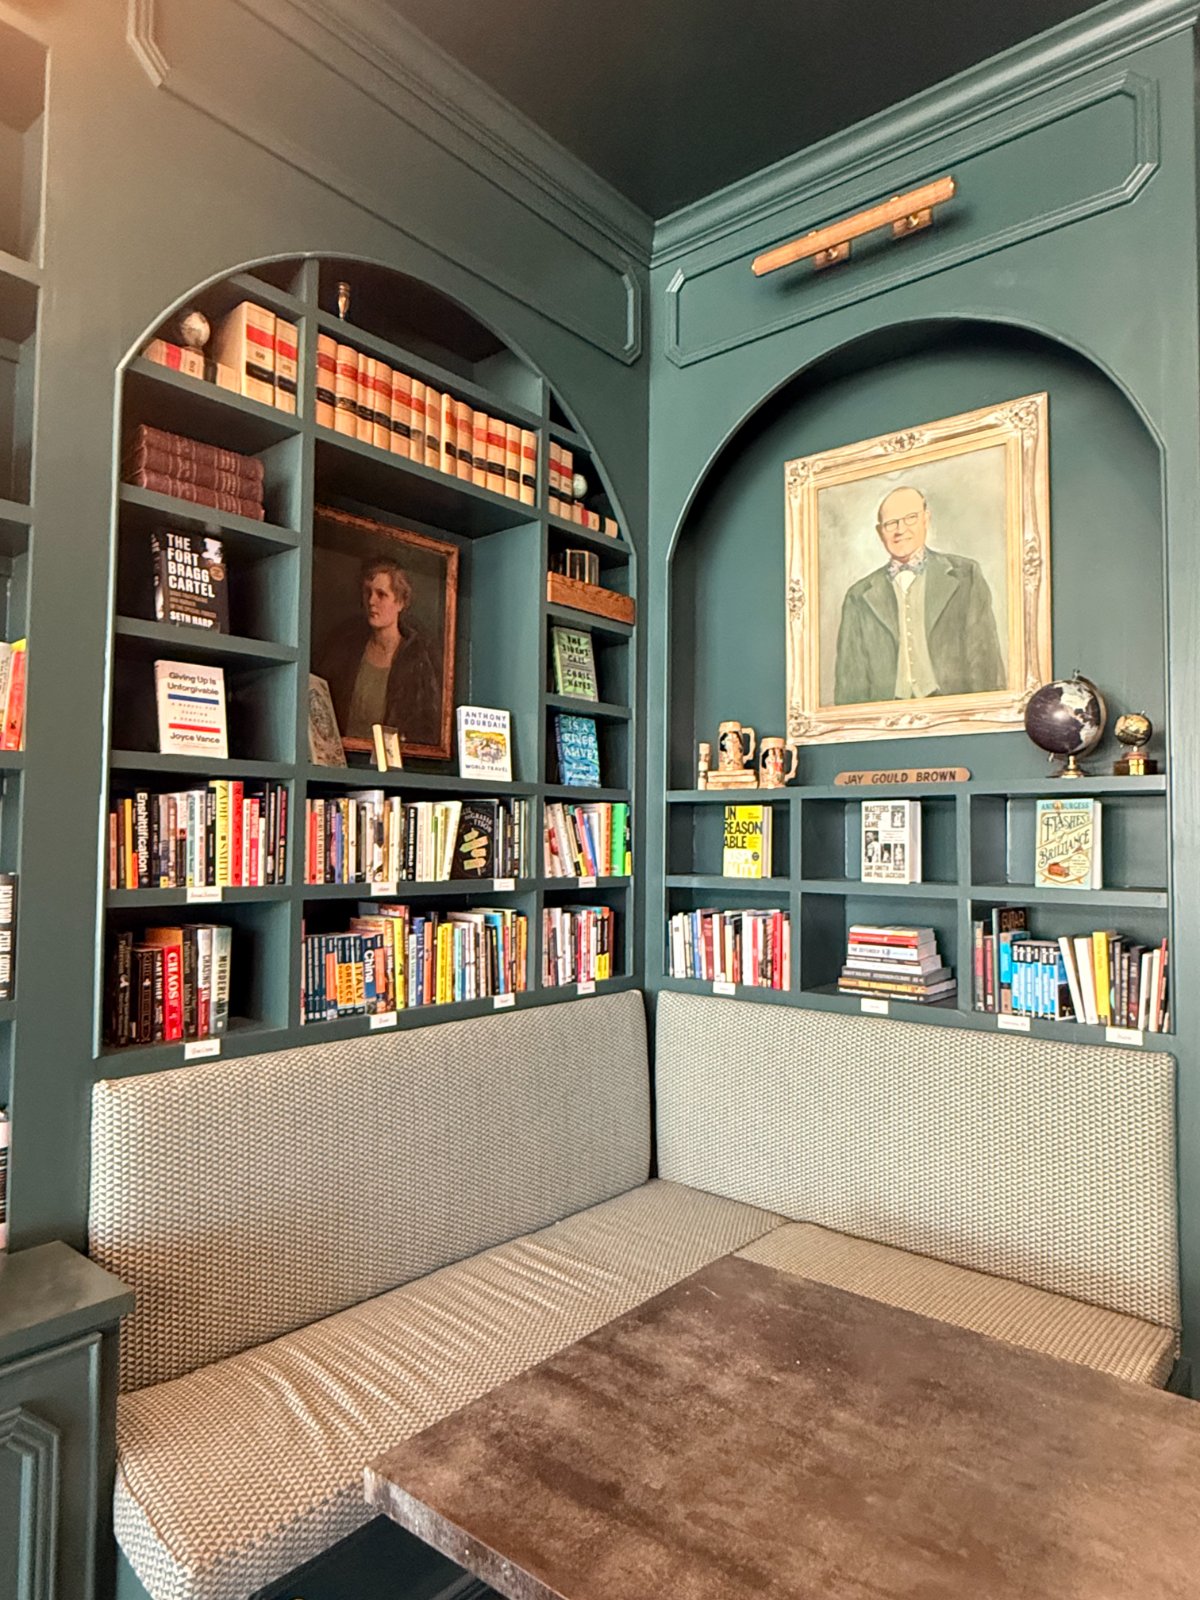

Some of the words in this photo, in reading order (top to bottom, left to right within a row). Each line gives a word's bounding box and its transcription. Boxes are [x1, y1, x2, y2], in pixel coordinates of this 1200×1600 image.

[166, 533, 191, 552] THE
[167, 547, 199, 567] FORT
[168, 561, 210, 583] BRAGG
[168, 575, 215, 598] CARTEL
[170, 611, 191, 624] SETH
[192, 616, 214, 628] HARP
[568, 655, 586, 665] CALL
[169, 672, 196, 683] Giving
[197, 676, 208, 685] Up
[167, 682, 219, 695] Unforgivable
[464, 719, 507, 729] BOURDAIN
[465, 711, 506, 721] ANTHONY
[170, 732, 195, 741] Joyce
[196, 735, 220, 743] Vance
[844, 774, 864, 785] JAY
[871, 772, 909, 784] GOULD
[916, 770, 957, 782] BROWN
[725, 806, 736, 820] UN
[864, 805, 890, 813] MASTERS
[872, 813, 882, 821] THE
[136, 792, 149, 873] Enshittification
[723, 821, 763, 835] REASON
[864, 821, 879, 829] GAME
[1043, 814, 1087, 842] FLASHES
[723, 835, 747, 849] ABLE
[1038, 829, 1090, 868] BRILLIANCE
[219, 843, 228, 880] SMITH
[168, 952, 179, 999] CHAOS
[202, 955, 211, 985] CHASING
[364, 950, 375, 983] China
[216, 955, 228, 1015] MURDERLAND
[345, 965, 353, 1003] GREECE
[355, 966, 363, 999] ITALY
[201, 984, 210, 1002] EVIL
